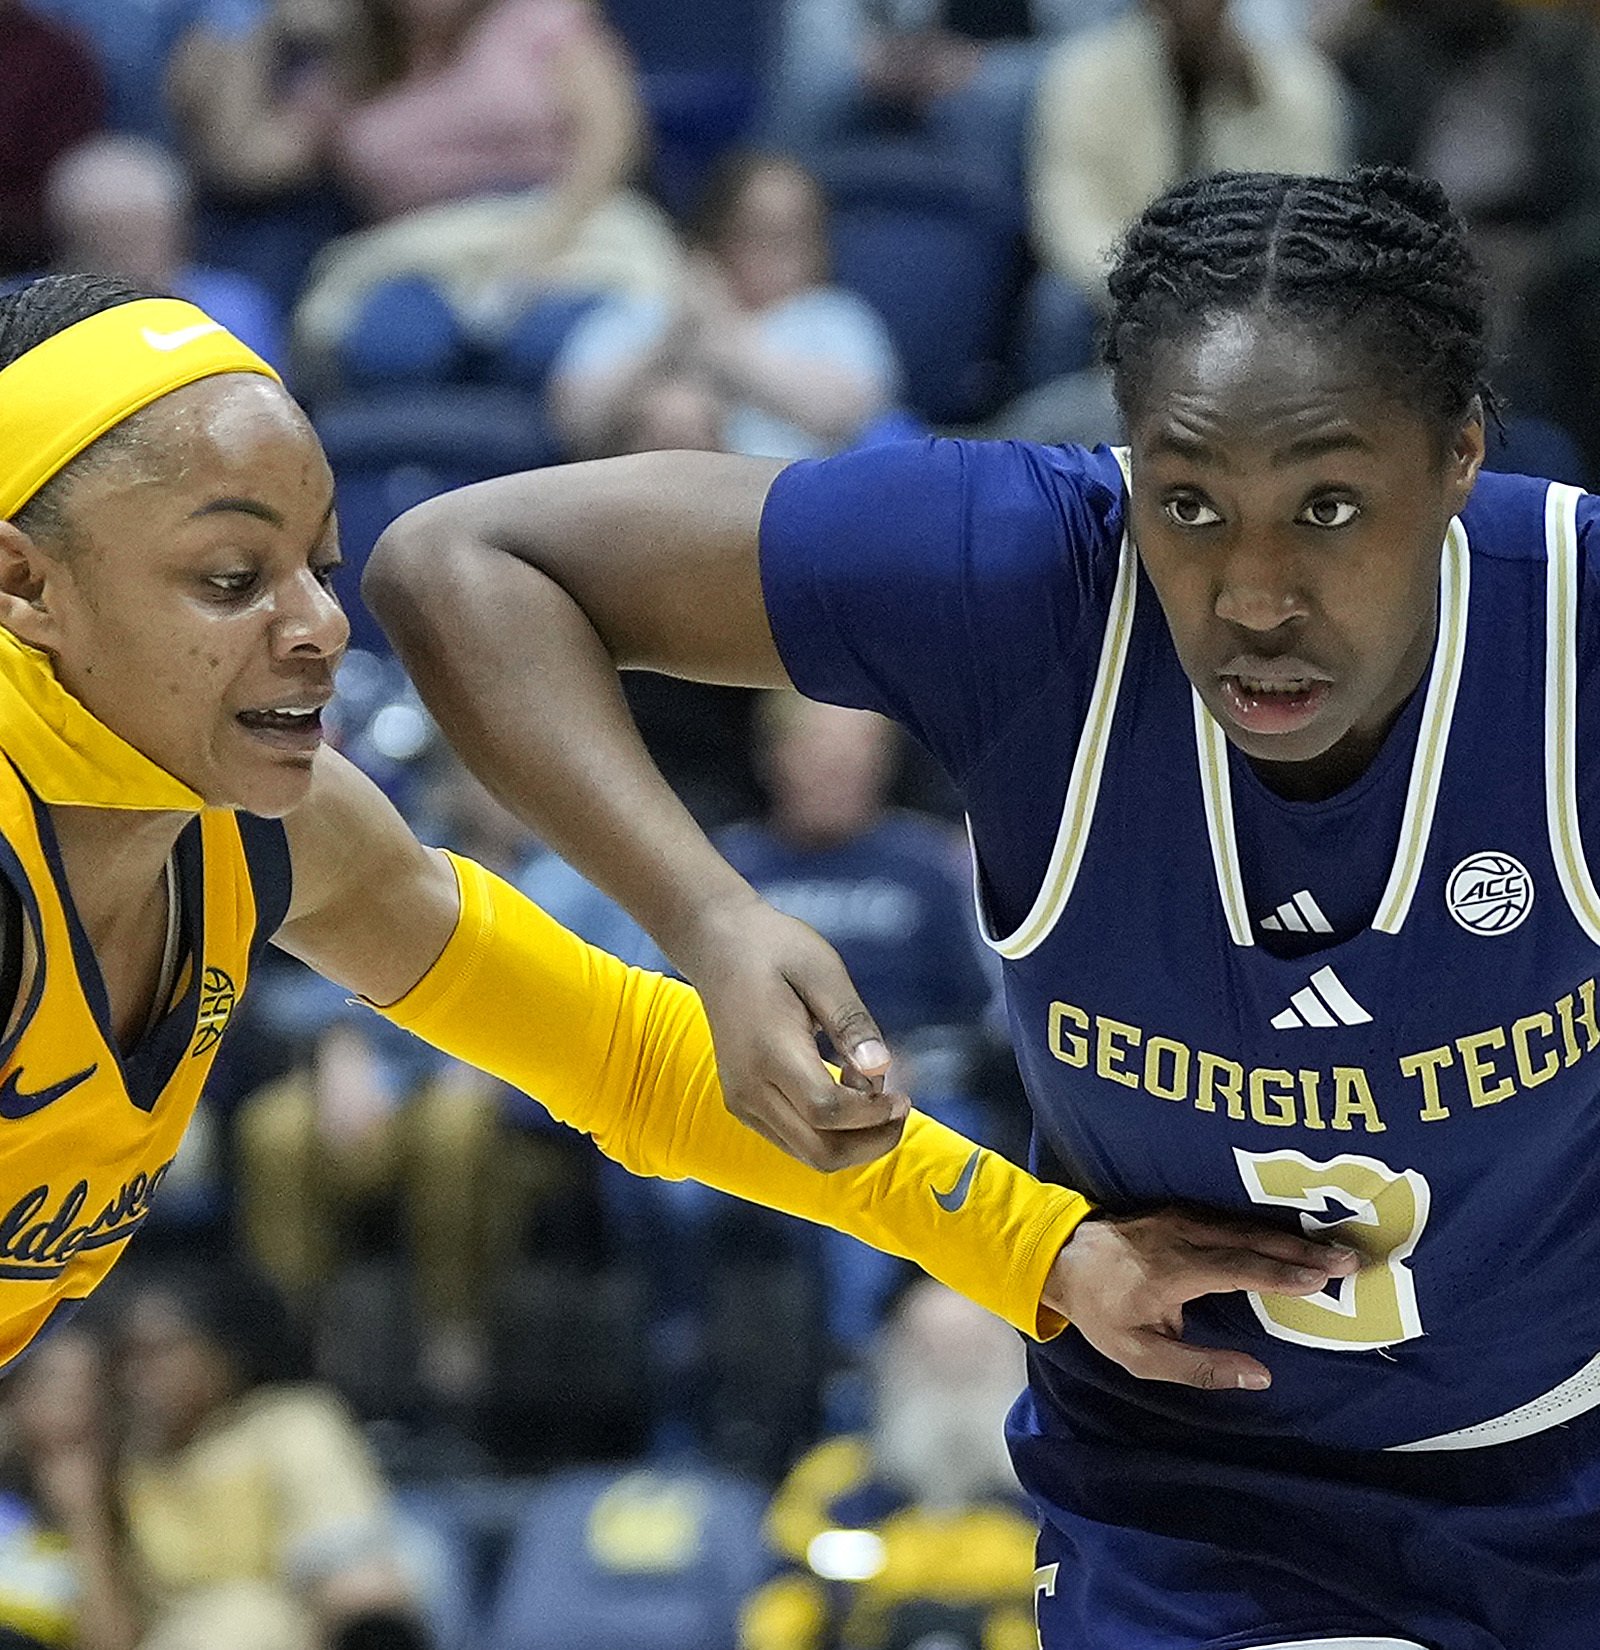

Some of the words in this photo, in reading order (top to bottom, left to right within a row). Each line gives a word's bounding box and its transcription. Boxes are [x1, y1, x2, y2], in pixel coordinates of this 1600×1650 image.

[1460, 874, 1524, 902] ACC
[1047, 1000, 1386, 1133] GEORGIA
[1232, 1146, 1431, 1350] 3
